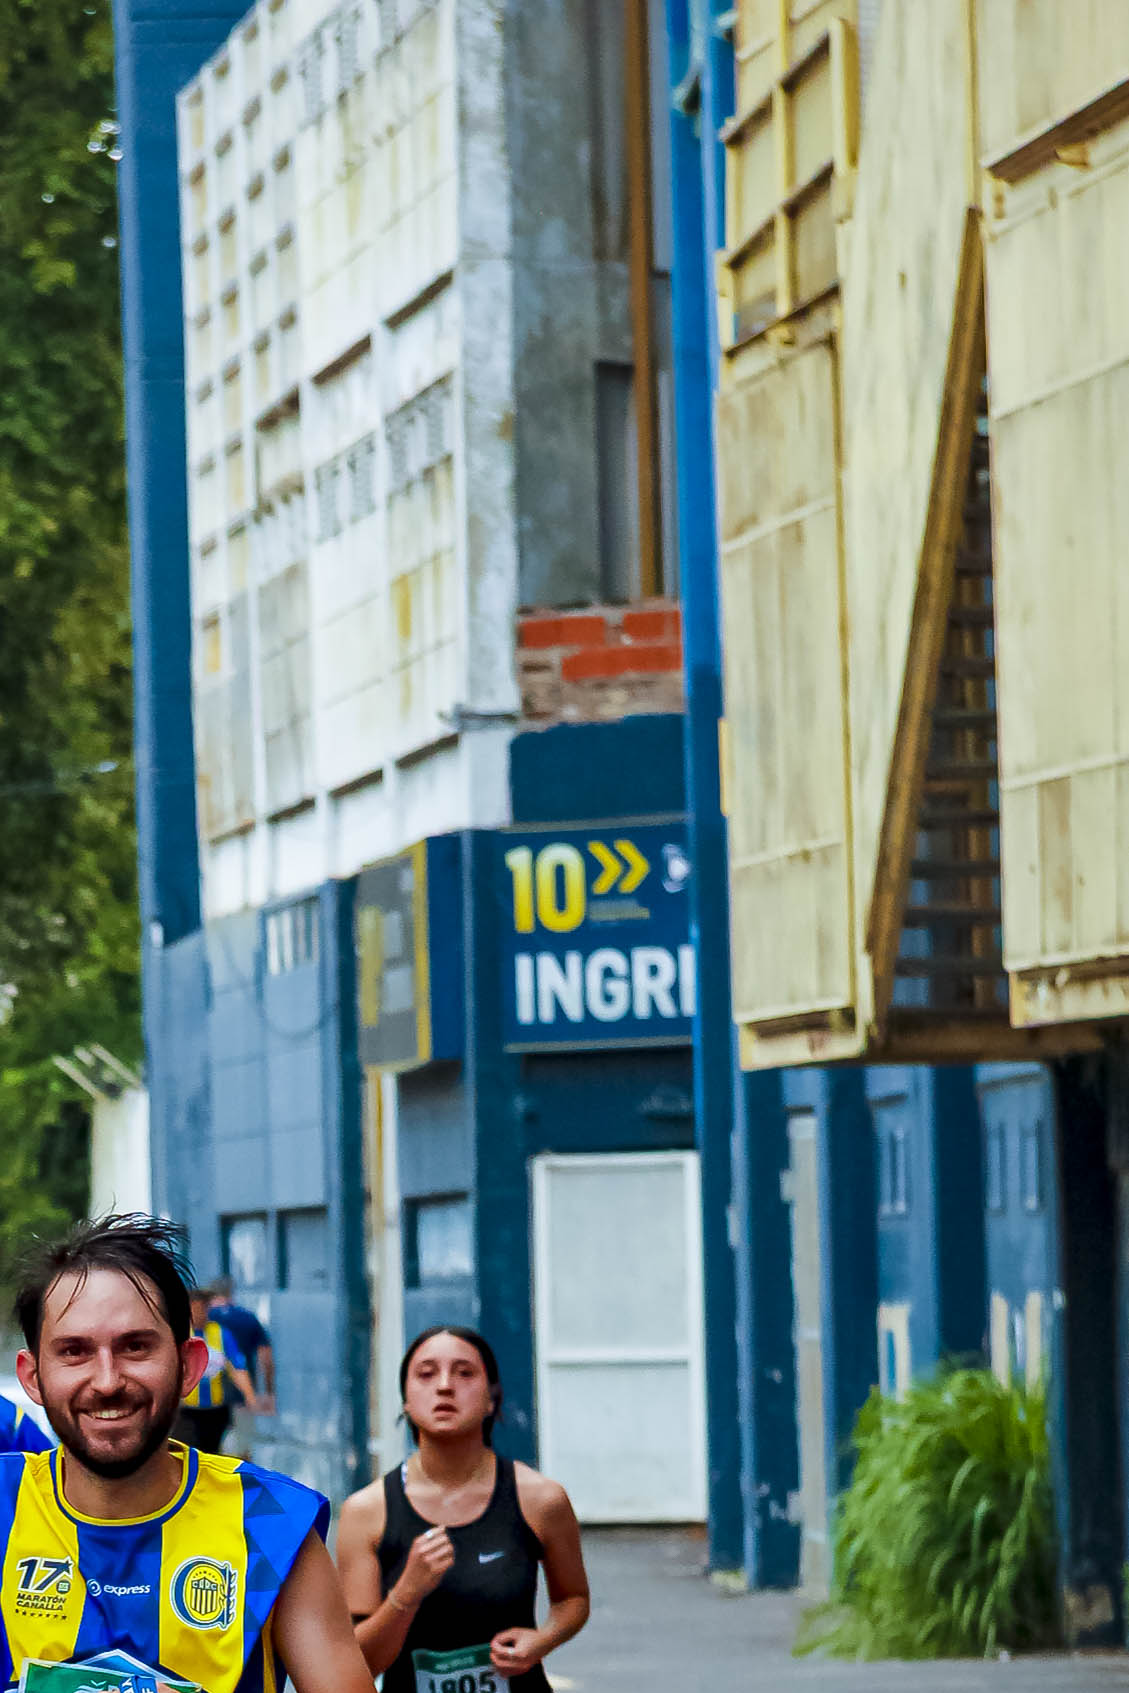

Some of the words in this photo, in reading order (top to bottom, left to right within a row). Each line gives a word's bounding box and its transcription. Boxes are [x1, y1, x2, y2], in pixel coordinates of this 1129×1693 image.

[504, 842, 587, 934] 10
[17, 1556, 73, 1593] 17
[103, 1584, 151, 1596] express
